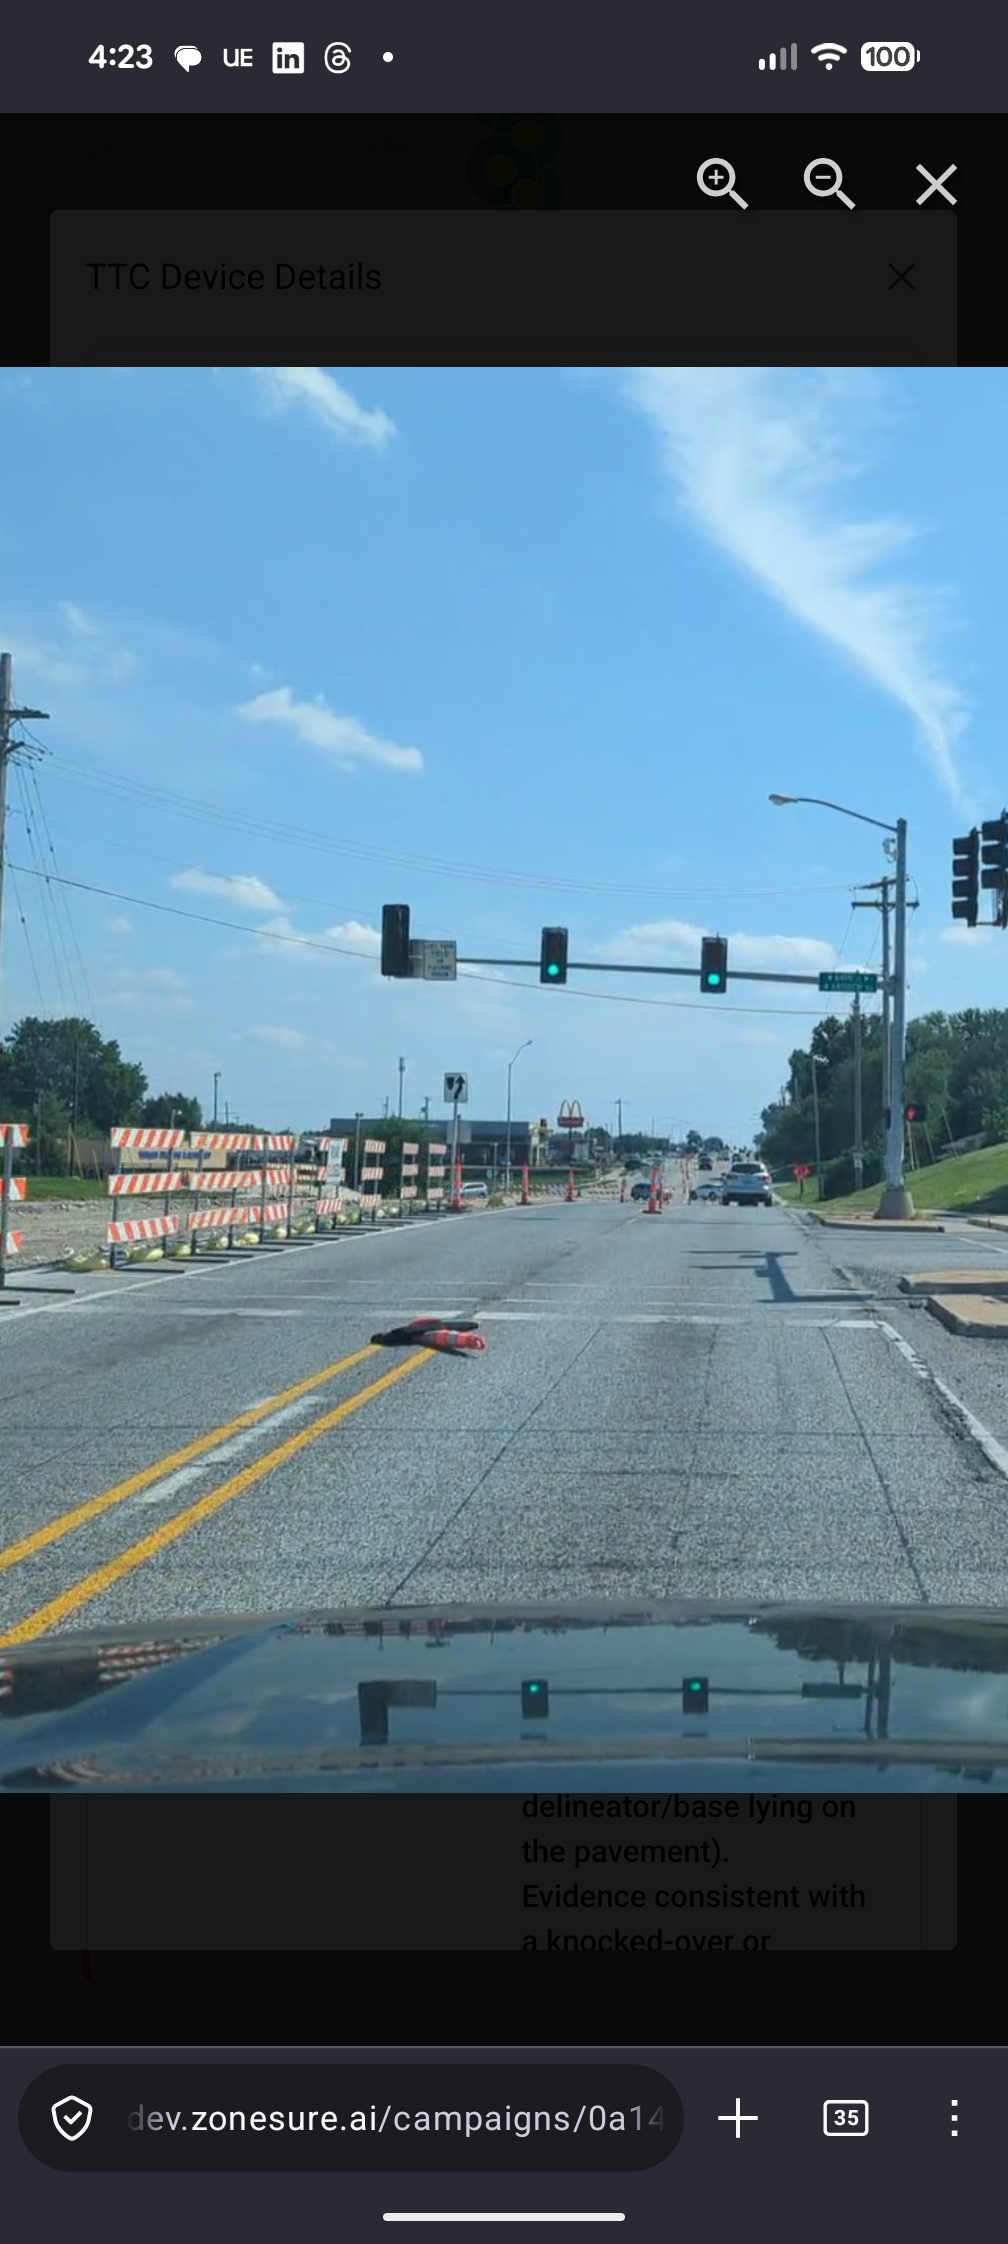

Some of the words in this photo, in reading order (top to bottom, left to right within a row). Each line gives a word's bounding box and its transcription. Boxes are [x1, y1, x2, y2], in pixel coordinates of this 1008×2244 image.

[88, 44, 153, 69] 4:23
[223, 48, 253, 67] UE
[865, 46, 911, 68] 100
[86, 262, 149, 289] TTC
[163, 262, 264, 289] Device
[277, 262, 382, 289] Details
[523, 1794, 740, 1820] delineator/base
[750, 1794, 813, 1826] lying
[823, 1799, 856, 1818] on
[522, 1838, 565, 1863] the
[575, 1837, 729, 1871] pavement).
[524, 1883, 646, 1908] Evidence
[655, 1884, 800, 1908] consistent
[808, 1883, 866, 1908] with
[523, 1934, 537, 1950] a
[548, 1928, 734, 1950] knocked-over
[743, 1934, 771, 1950] or
[833, 2108, 860, 2127] 35
